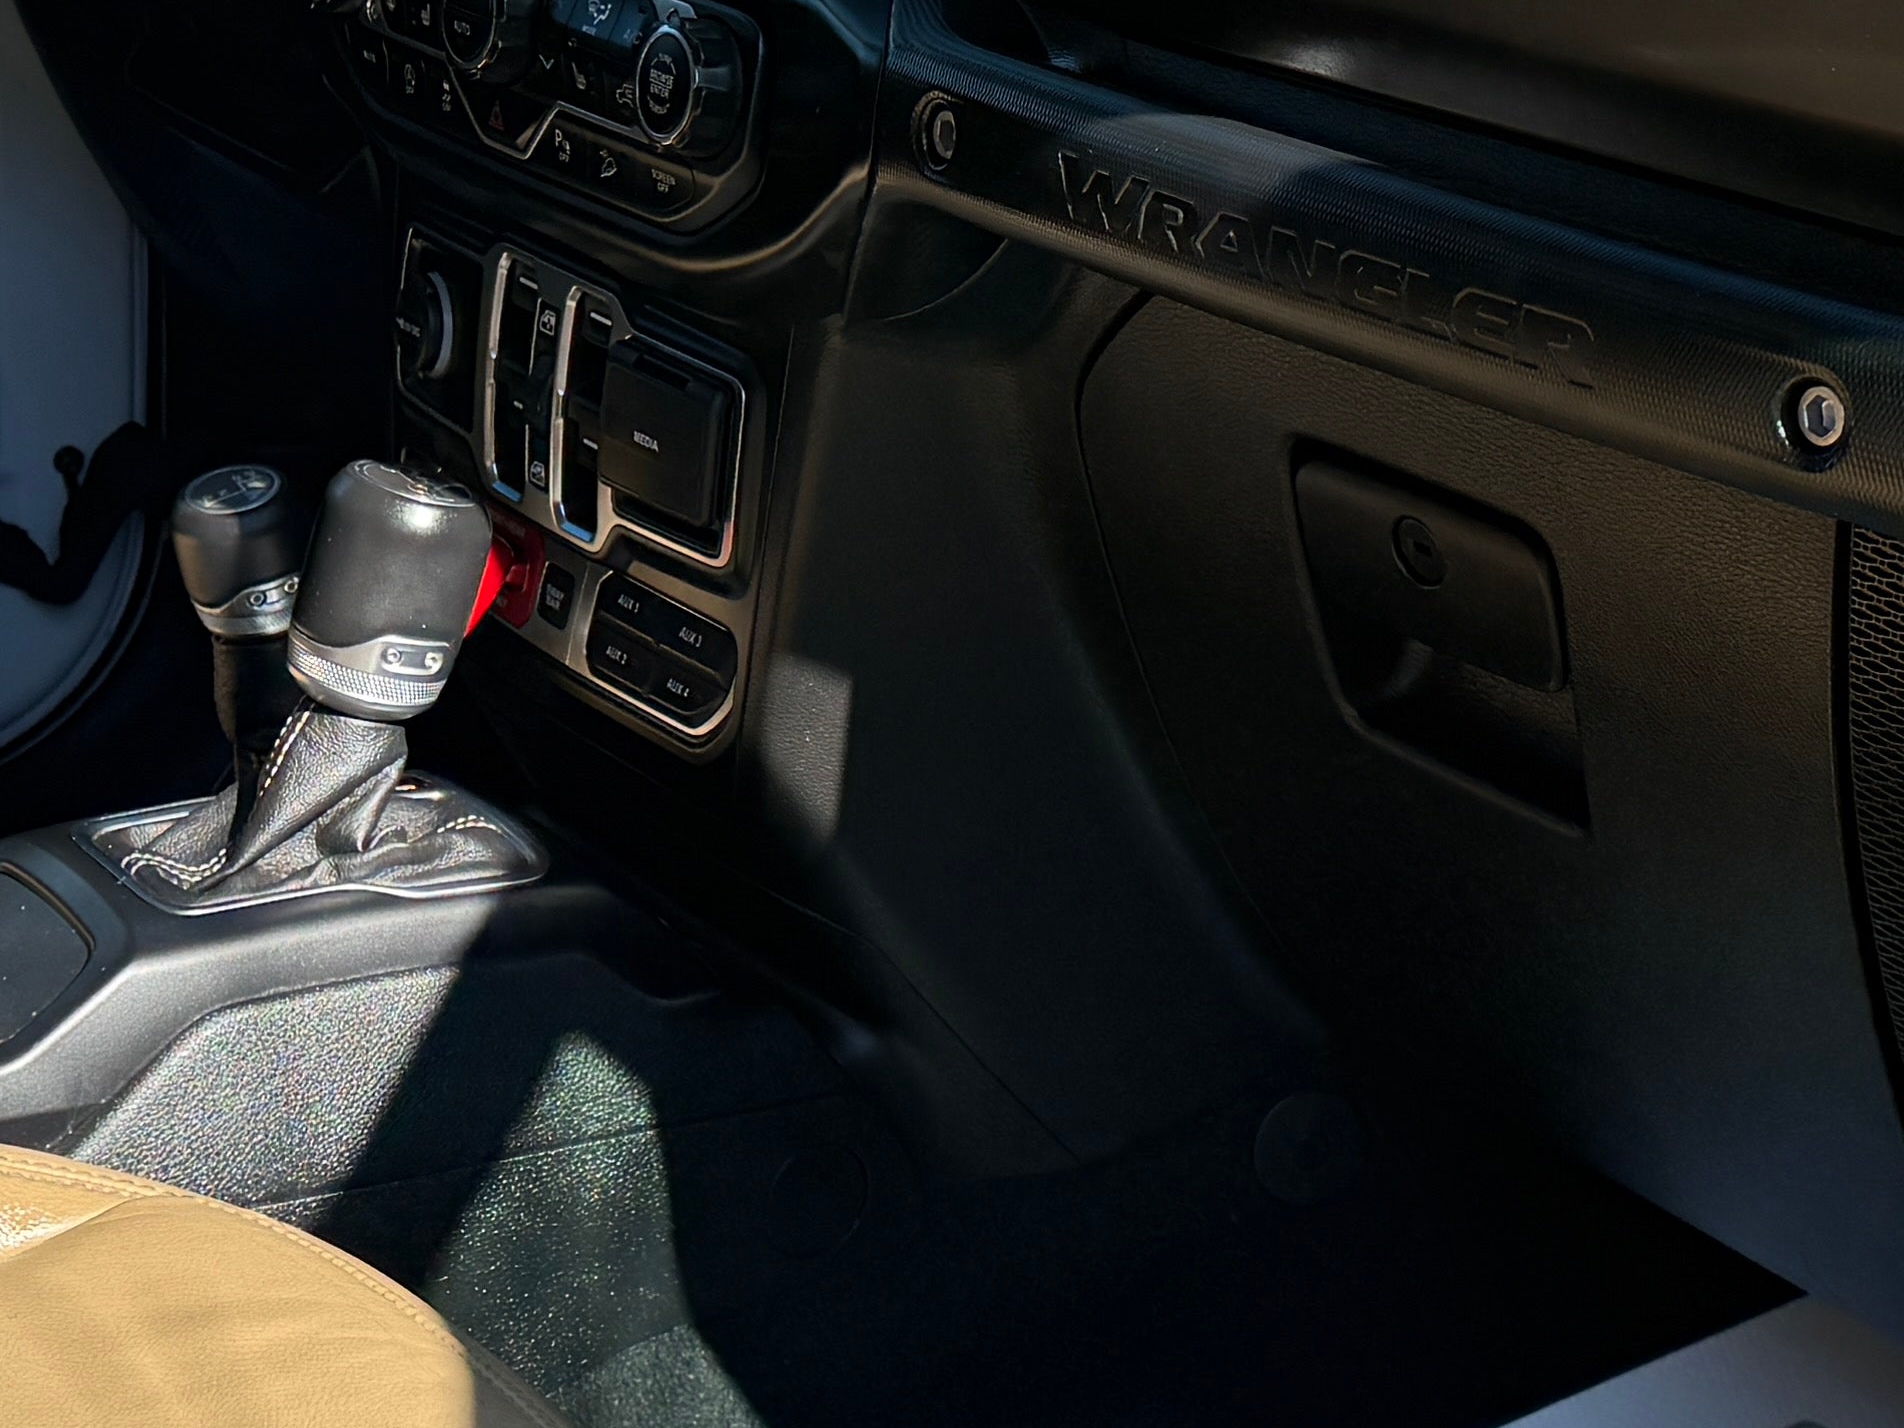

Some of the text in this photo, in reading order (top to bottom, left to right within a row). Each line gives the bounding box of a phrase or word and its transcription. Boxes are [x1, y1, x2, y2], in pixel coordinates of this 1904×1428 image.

[1056, 148, 1600, 390] WRANGLER
[633, 430, 659, 452] MEDIA
[617, 593, 633, 609] AUX
[678, 626, 695, 645] AUX
[605, 645, 621, 661] AUX
[666, 678, 683, 693] AUX
